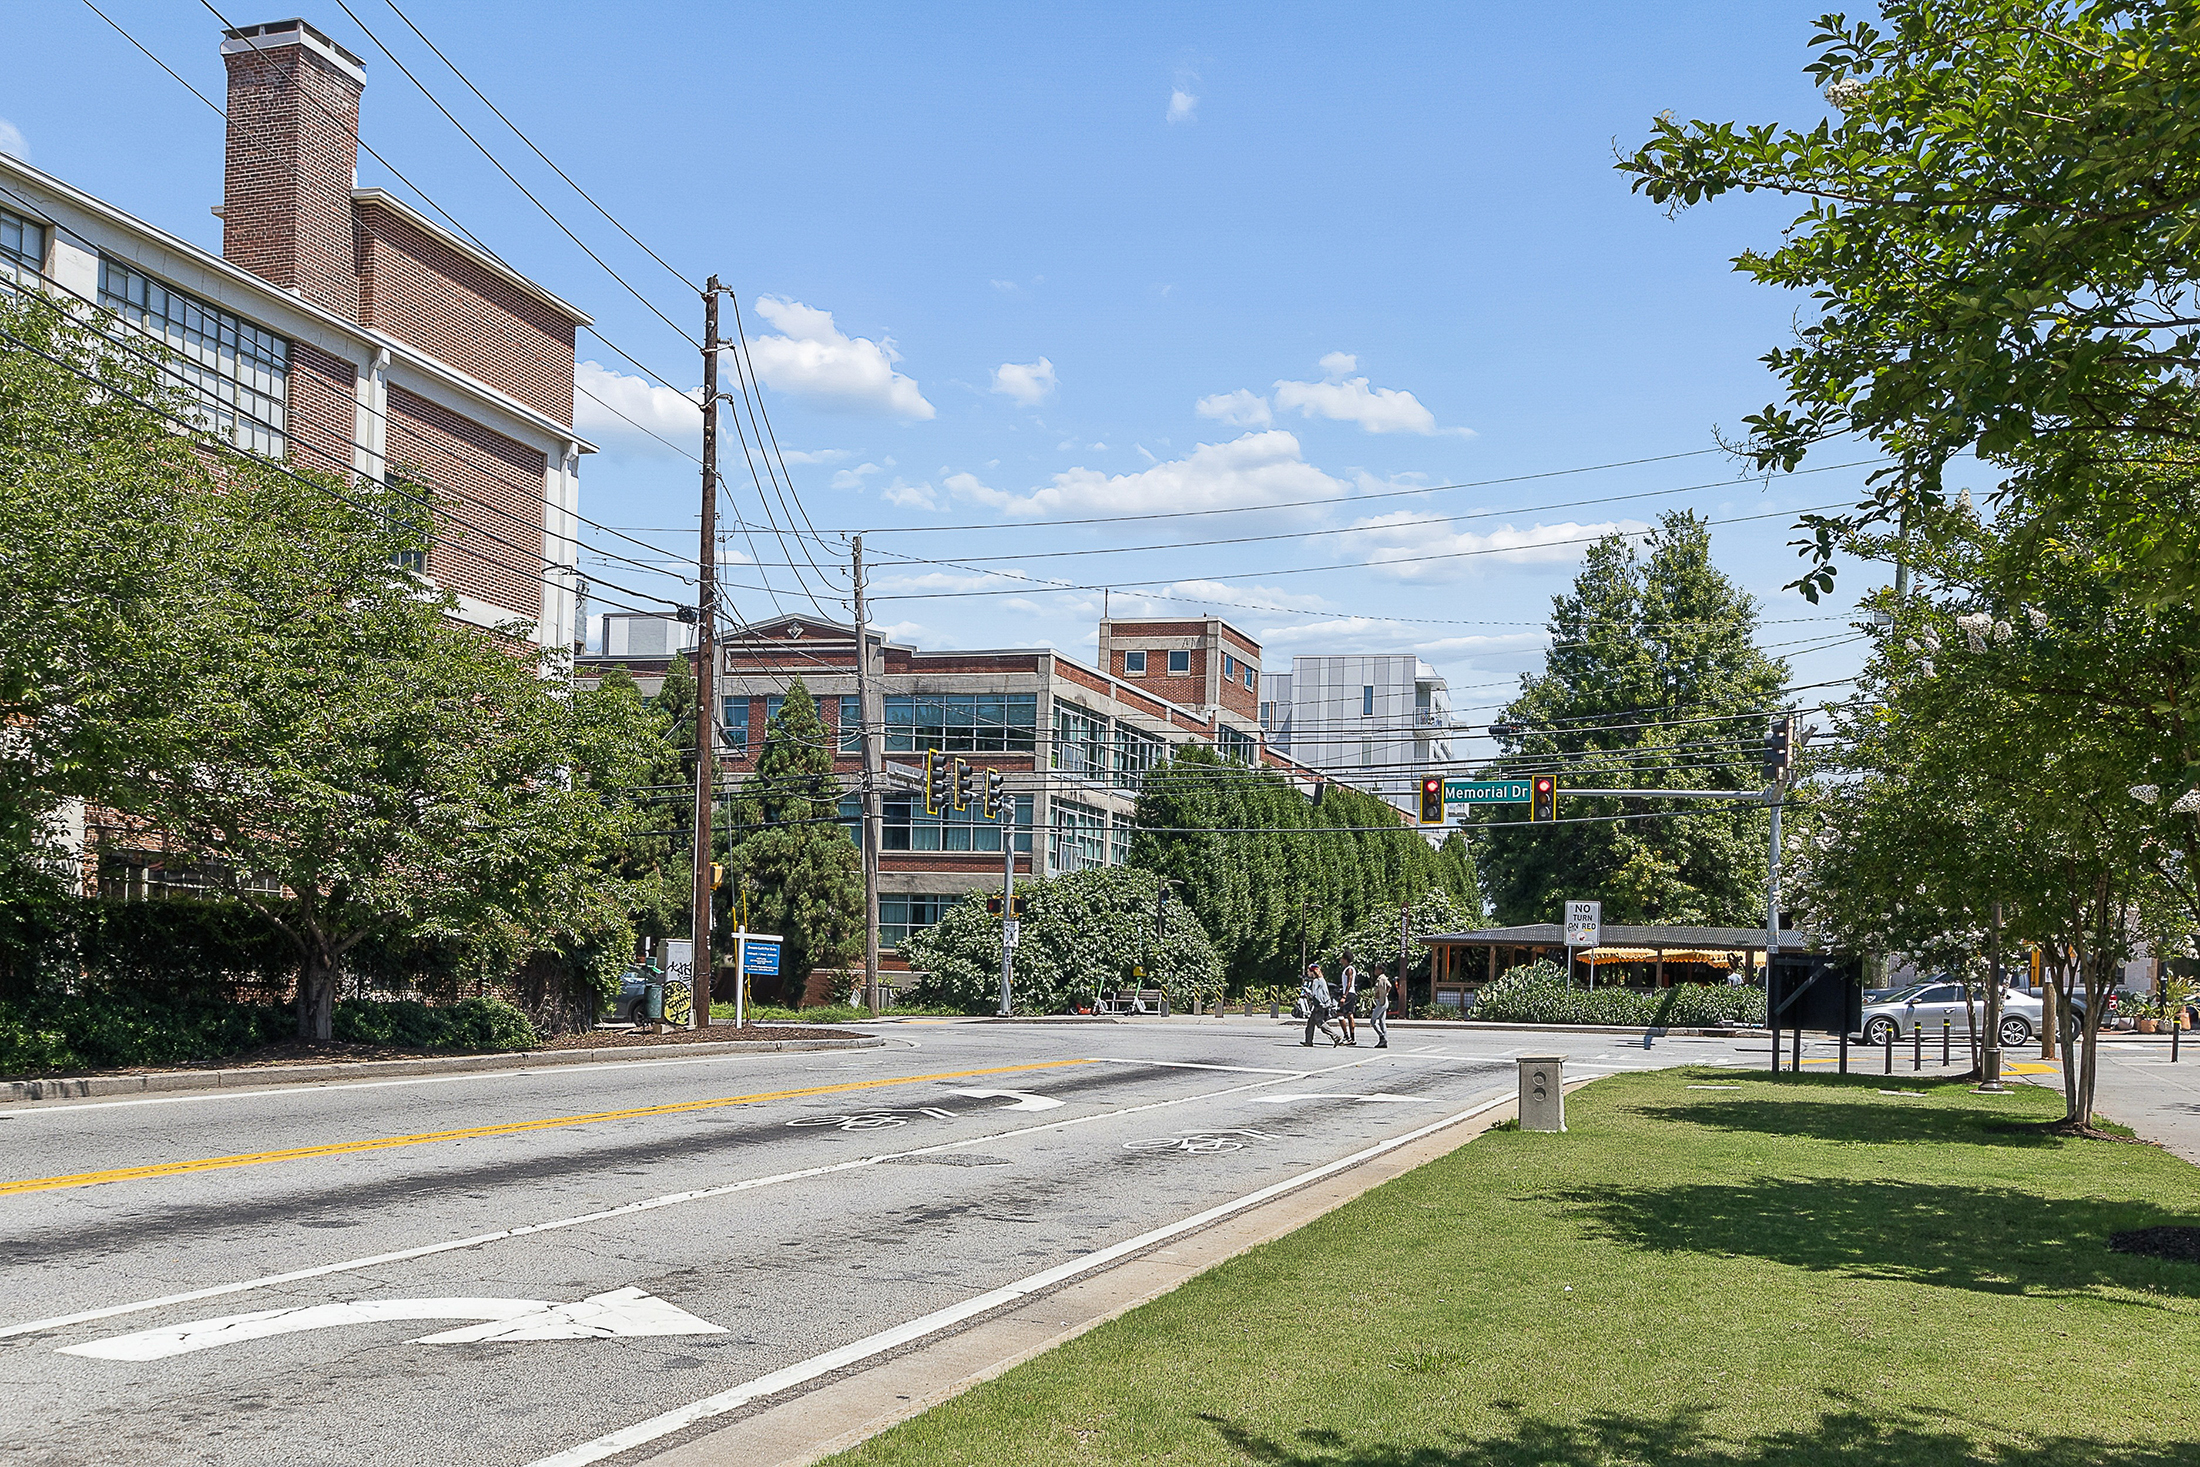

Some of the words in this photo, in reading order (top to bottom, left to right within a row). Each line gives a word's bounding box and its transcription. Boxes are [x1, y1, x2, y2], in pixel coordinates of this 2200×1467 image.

[1445, 786, 1507, 799] Memorial
[1512, 785, 1528, 798] Dr
[1575, 904, 1591, 913] NO
